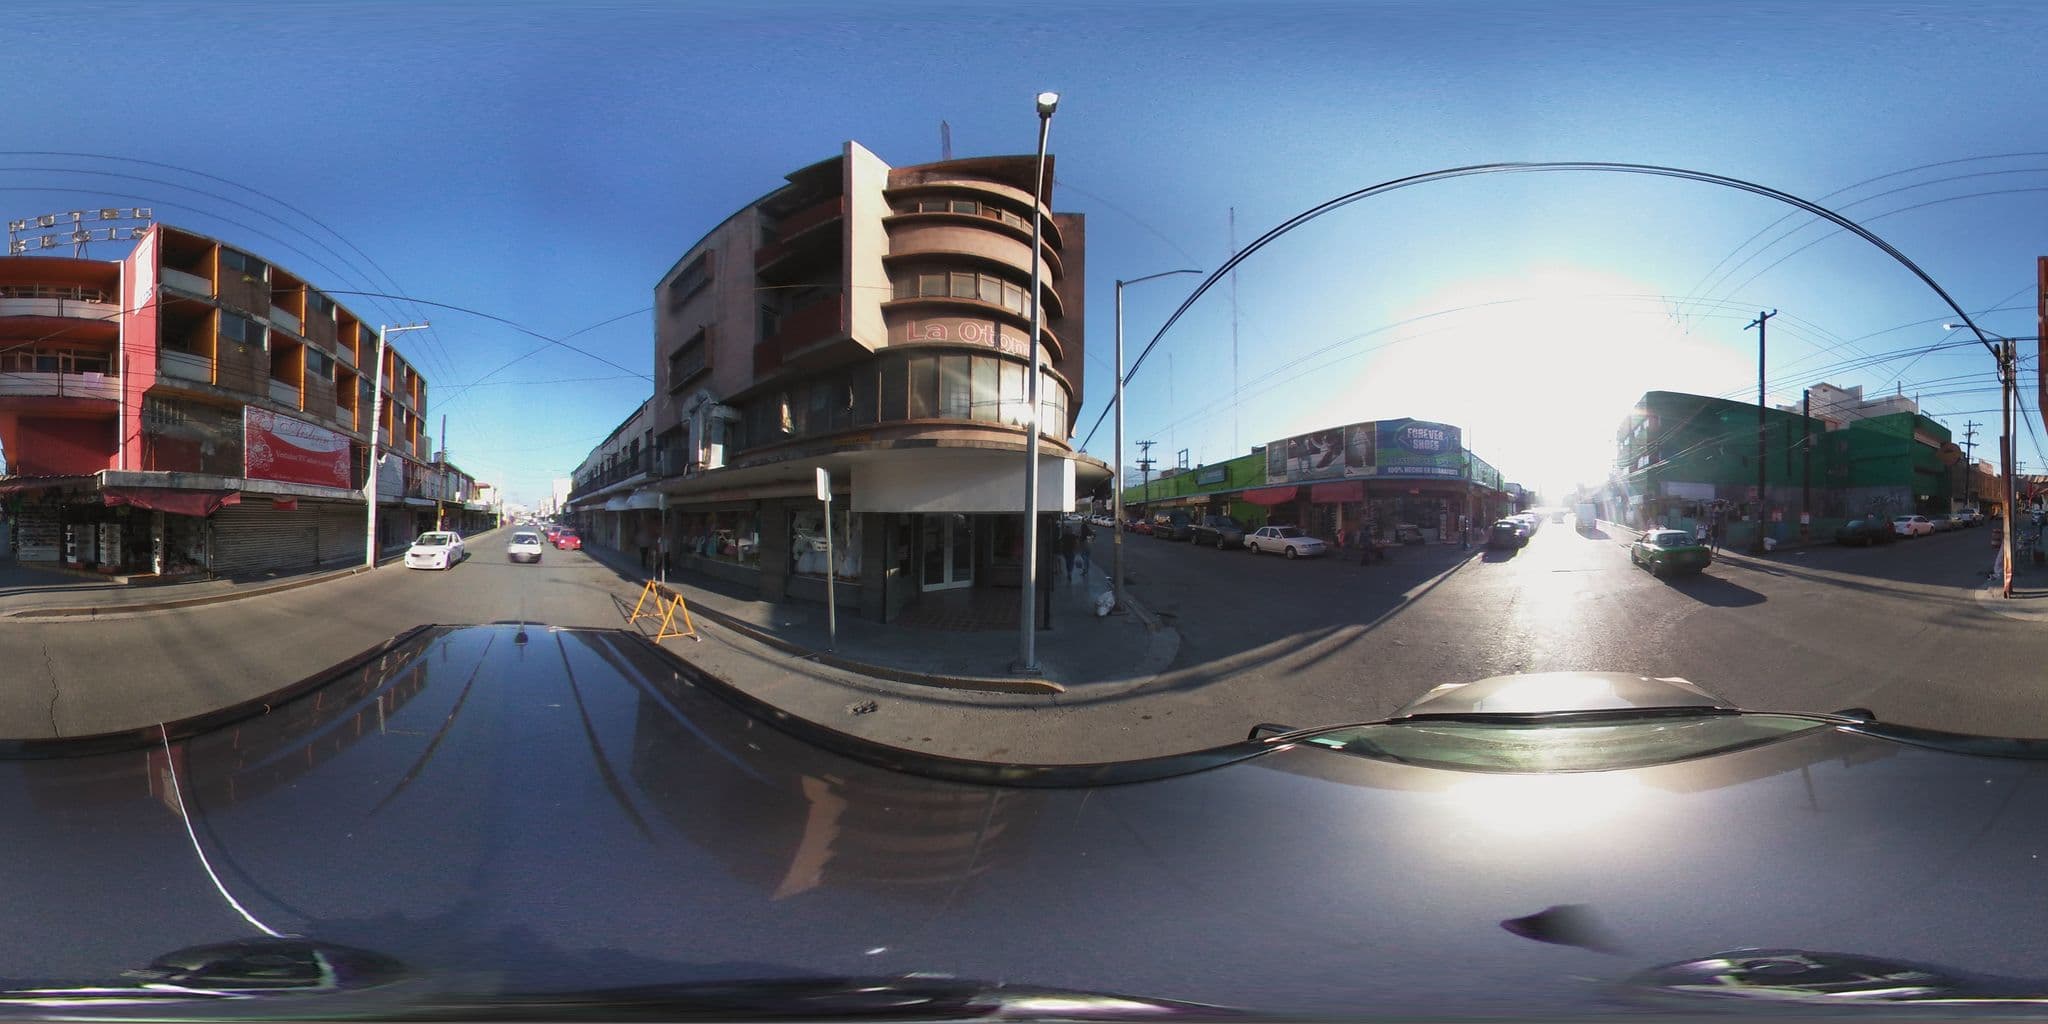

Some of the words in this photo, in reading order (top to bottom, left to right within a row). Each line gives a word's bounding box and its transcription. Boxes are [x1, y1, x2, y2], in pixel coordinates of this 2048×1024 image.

[9, 208, 152, 232] HOTEL
[906, 319, 948, 342] La
[1407, 427, 1444, 441] FOREVER
[1413, 439, 1440, 450] SHOES
